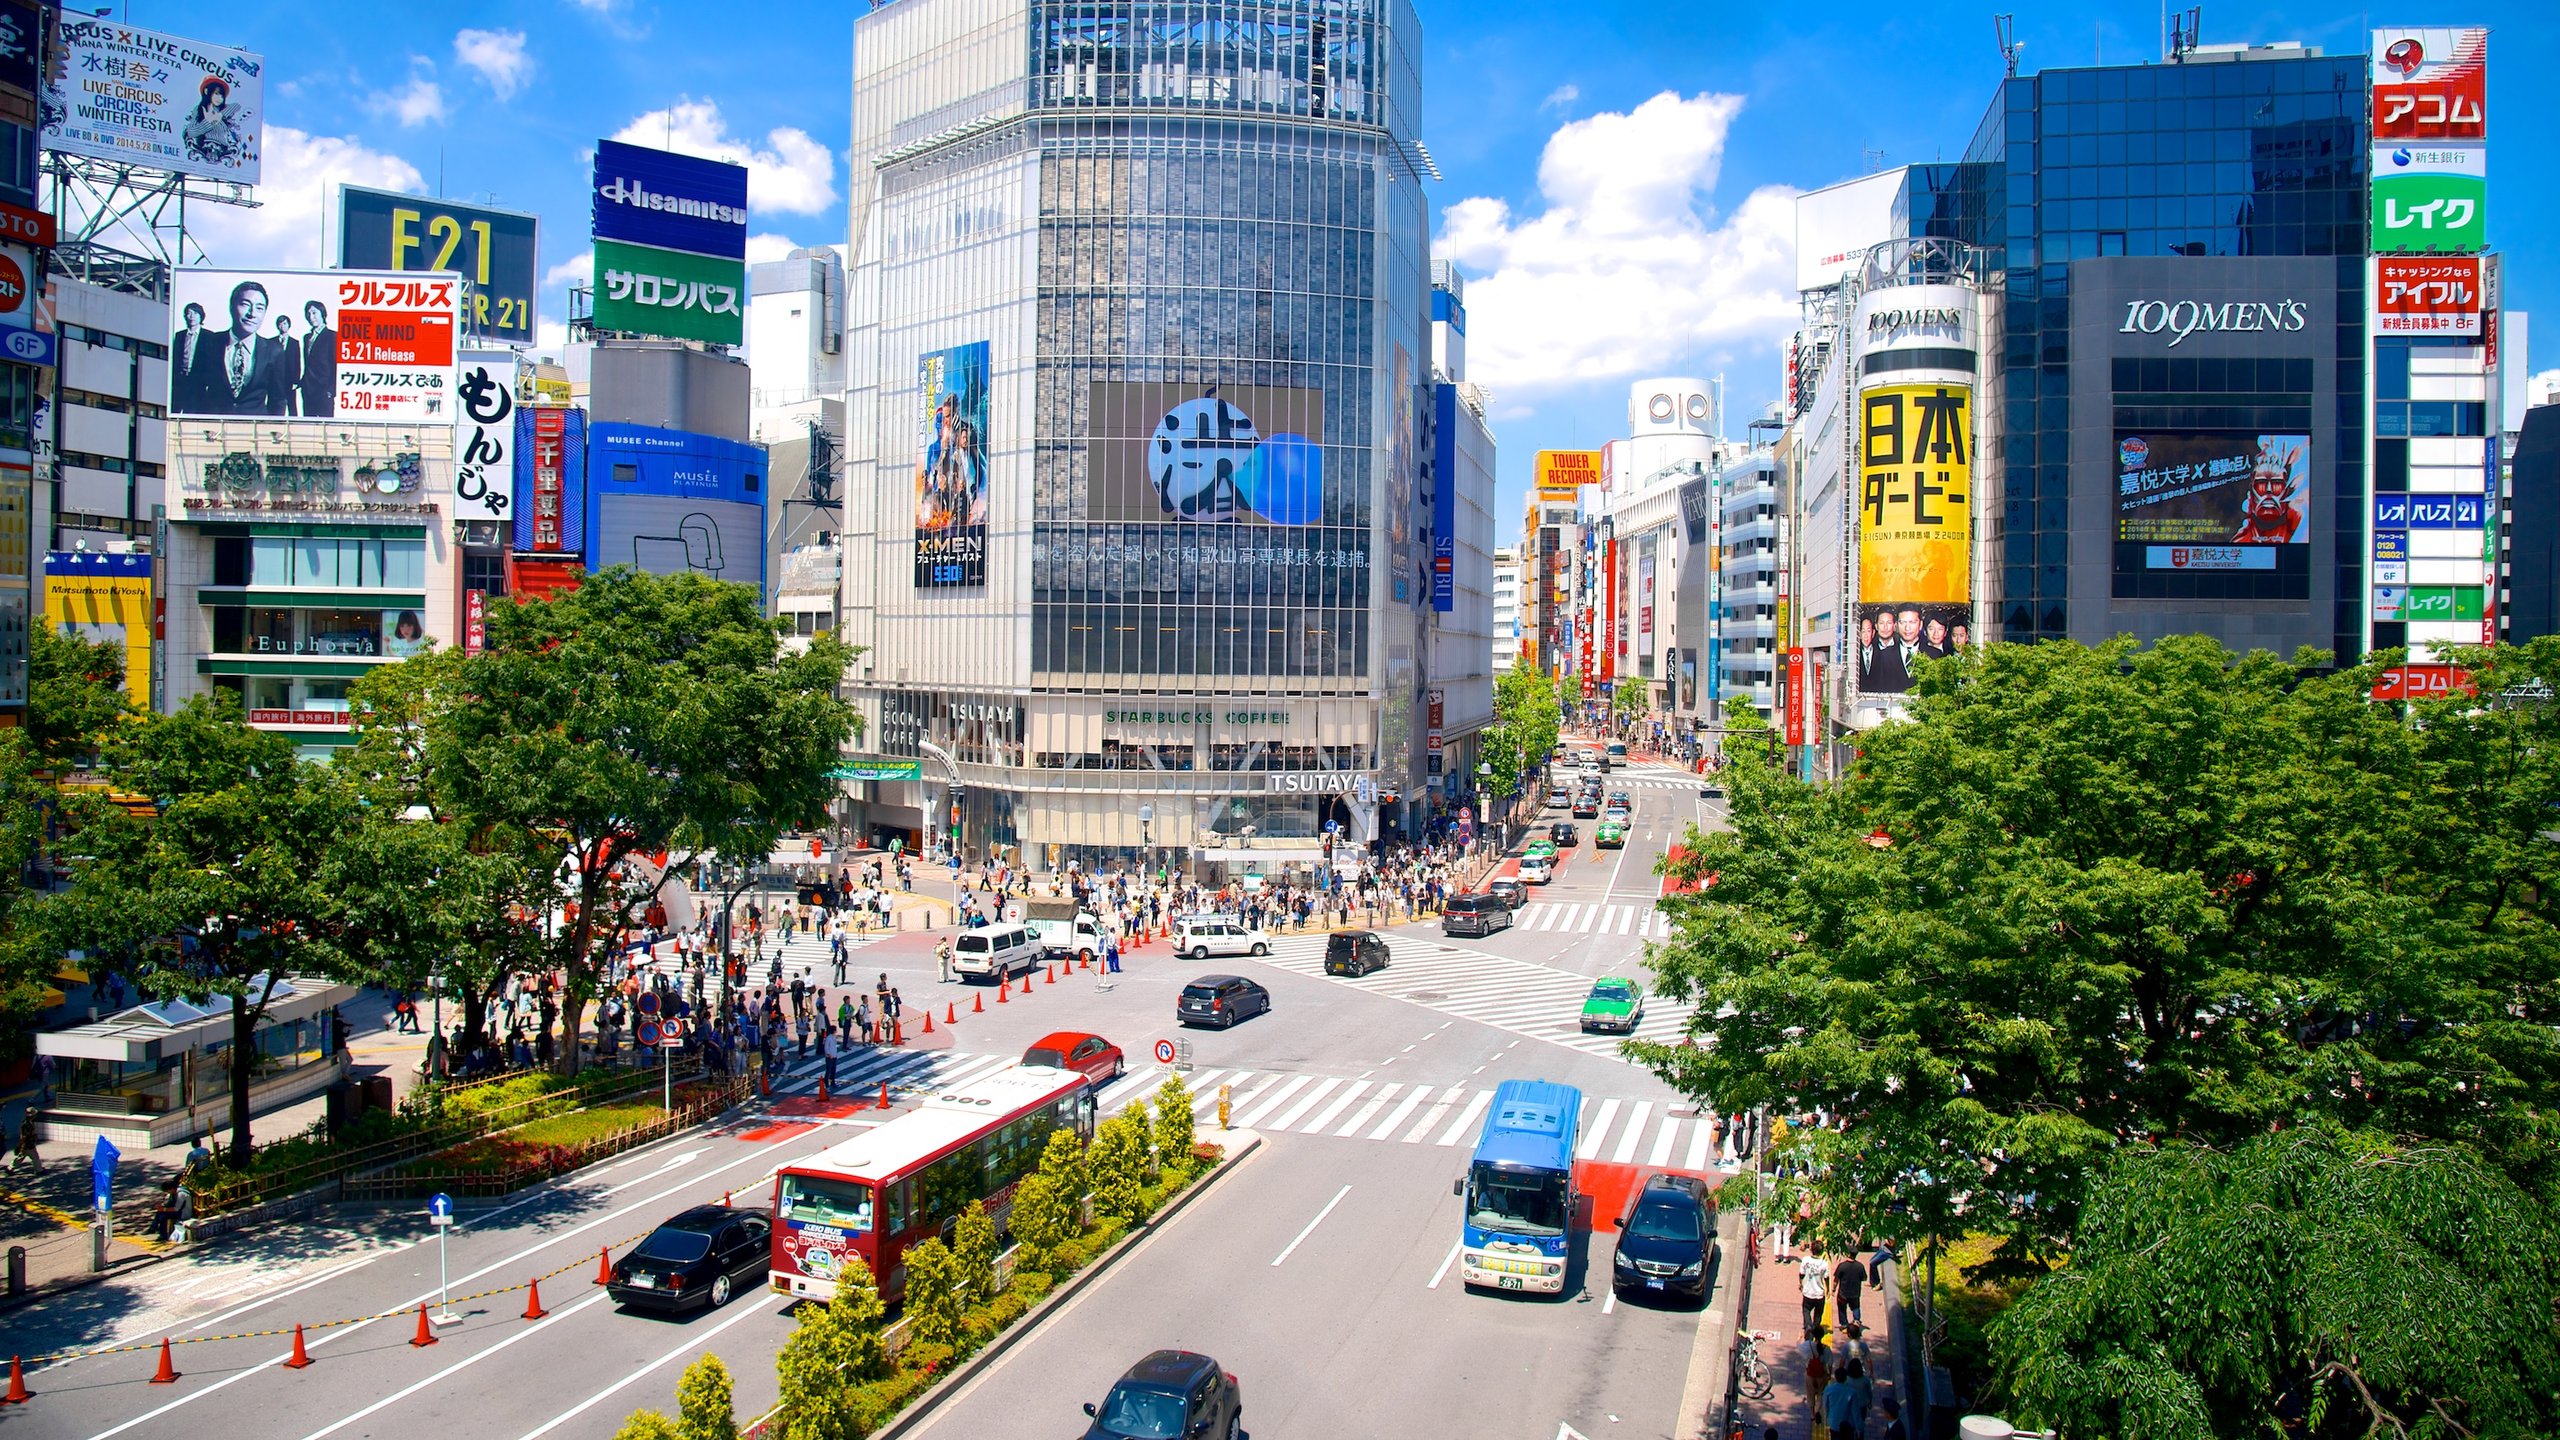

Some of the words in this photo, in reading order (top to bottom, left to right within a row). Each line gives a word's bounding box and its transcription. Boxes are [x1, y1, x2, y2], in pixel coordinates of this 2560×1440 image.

[136, 35, 178, 57] LIVE
[106, 43, 149, 58] WINTER
[152, 53, 181, 70] FESTA
[82, 52, 169, 84] 水樹奈々
[83, 79, 111, 95] LIVE
[2383, 94, 2482, 124] アコム
[78, 104, 129, 126] WINTER
[134, 115, 172, 134] FESTA
[66, 128, 81, 139] LIVE
[82, 131, 92, 142] BD
[94, 133, 99, 142] &
[101, 133, 115, 145] DVD
[116, 137, 150, 152] 2014.5.28
[152, 143, 163, 153] ON
[163, 145, 180, 157] SALE
[2415, 151, 2465, 164] 新生銀行
[601, 176, 747, 225] Hisamitsu
[2385, 198, 2475, 230] レイク
[392, 208, 491, 285] F21
[1821, 254, 1845, 266] 広告募集
[2385, 266, 2471, 278] キャッシングなら
[339, 281, 453, 307] ウルフルズ
[605, 268, 740, 317] サロンパス
[2384, 281, 2473, 305] アイフル
[498, 297, 527, 330] 21
[341, 323, 371, 339] ONE
[375, 324, 415, 340] MIND
[2382, 318, 2449, 330] 新規会員募集中
[2456, 319, 2474, 329] 8F
[14, 336, 39, 354] 6F
[341, 342, 371, 360] 5.21
[374, 347, 415, 362] Release
[341, 392, 371, 409] 5.20
[1865, 388, 1966, 468] 日本
[459, 366, 511, 515] もんじゃ
[607, 436, 641, 445] MUSEE
[645, 438, 704, 448] Channel
[1552, 454, 1589, 468] TOWER
[535, 412, 559, 545] 三千里薬品
[674, 480, 719, 488] PLATINUM
[1548, 470, 1597, 484] RECORDS
[2120, 464, 2190, 496] 嘉悦大学
[1864, 471, 1965, 526] ダービー
[1895, 531, 1930, 540] 東京競馬場
[2486, 525, 2494, 555] レイク
[2191, 548, 2243, 560] 嘉悦大学
[2383, 572, 2396, 581] 6F
[51, 585, 108, 596] Matsumoto
[110, 585, 146, 597] KiYoshi
[2409, 595, 2451, 610] レイク
[258, 636, 374, 656] Euphoria
[2381, 673, 2447, 691] アコム
[253, 712, 288, 722] 国内旅行
[297, 713, 331, 723] 海外旅行
[884, 711, 914, 726] BOOK
[951, 703, 1013, 722] TSUTAYA
[1106, 710, 1214, 725] STARBUCKS
[1226, 711, 1290, 725] COFFEE
[883, 730, 913, 745] CAFE
[1271, 774, 1362, 792] TSUTAYA
[804, 1224, 823, 1233] KEIO
[824, 1226, 843, 1236] BUS
